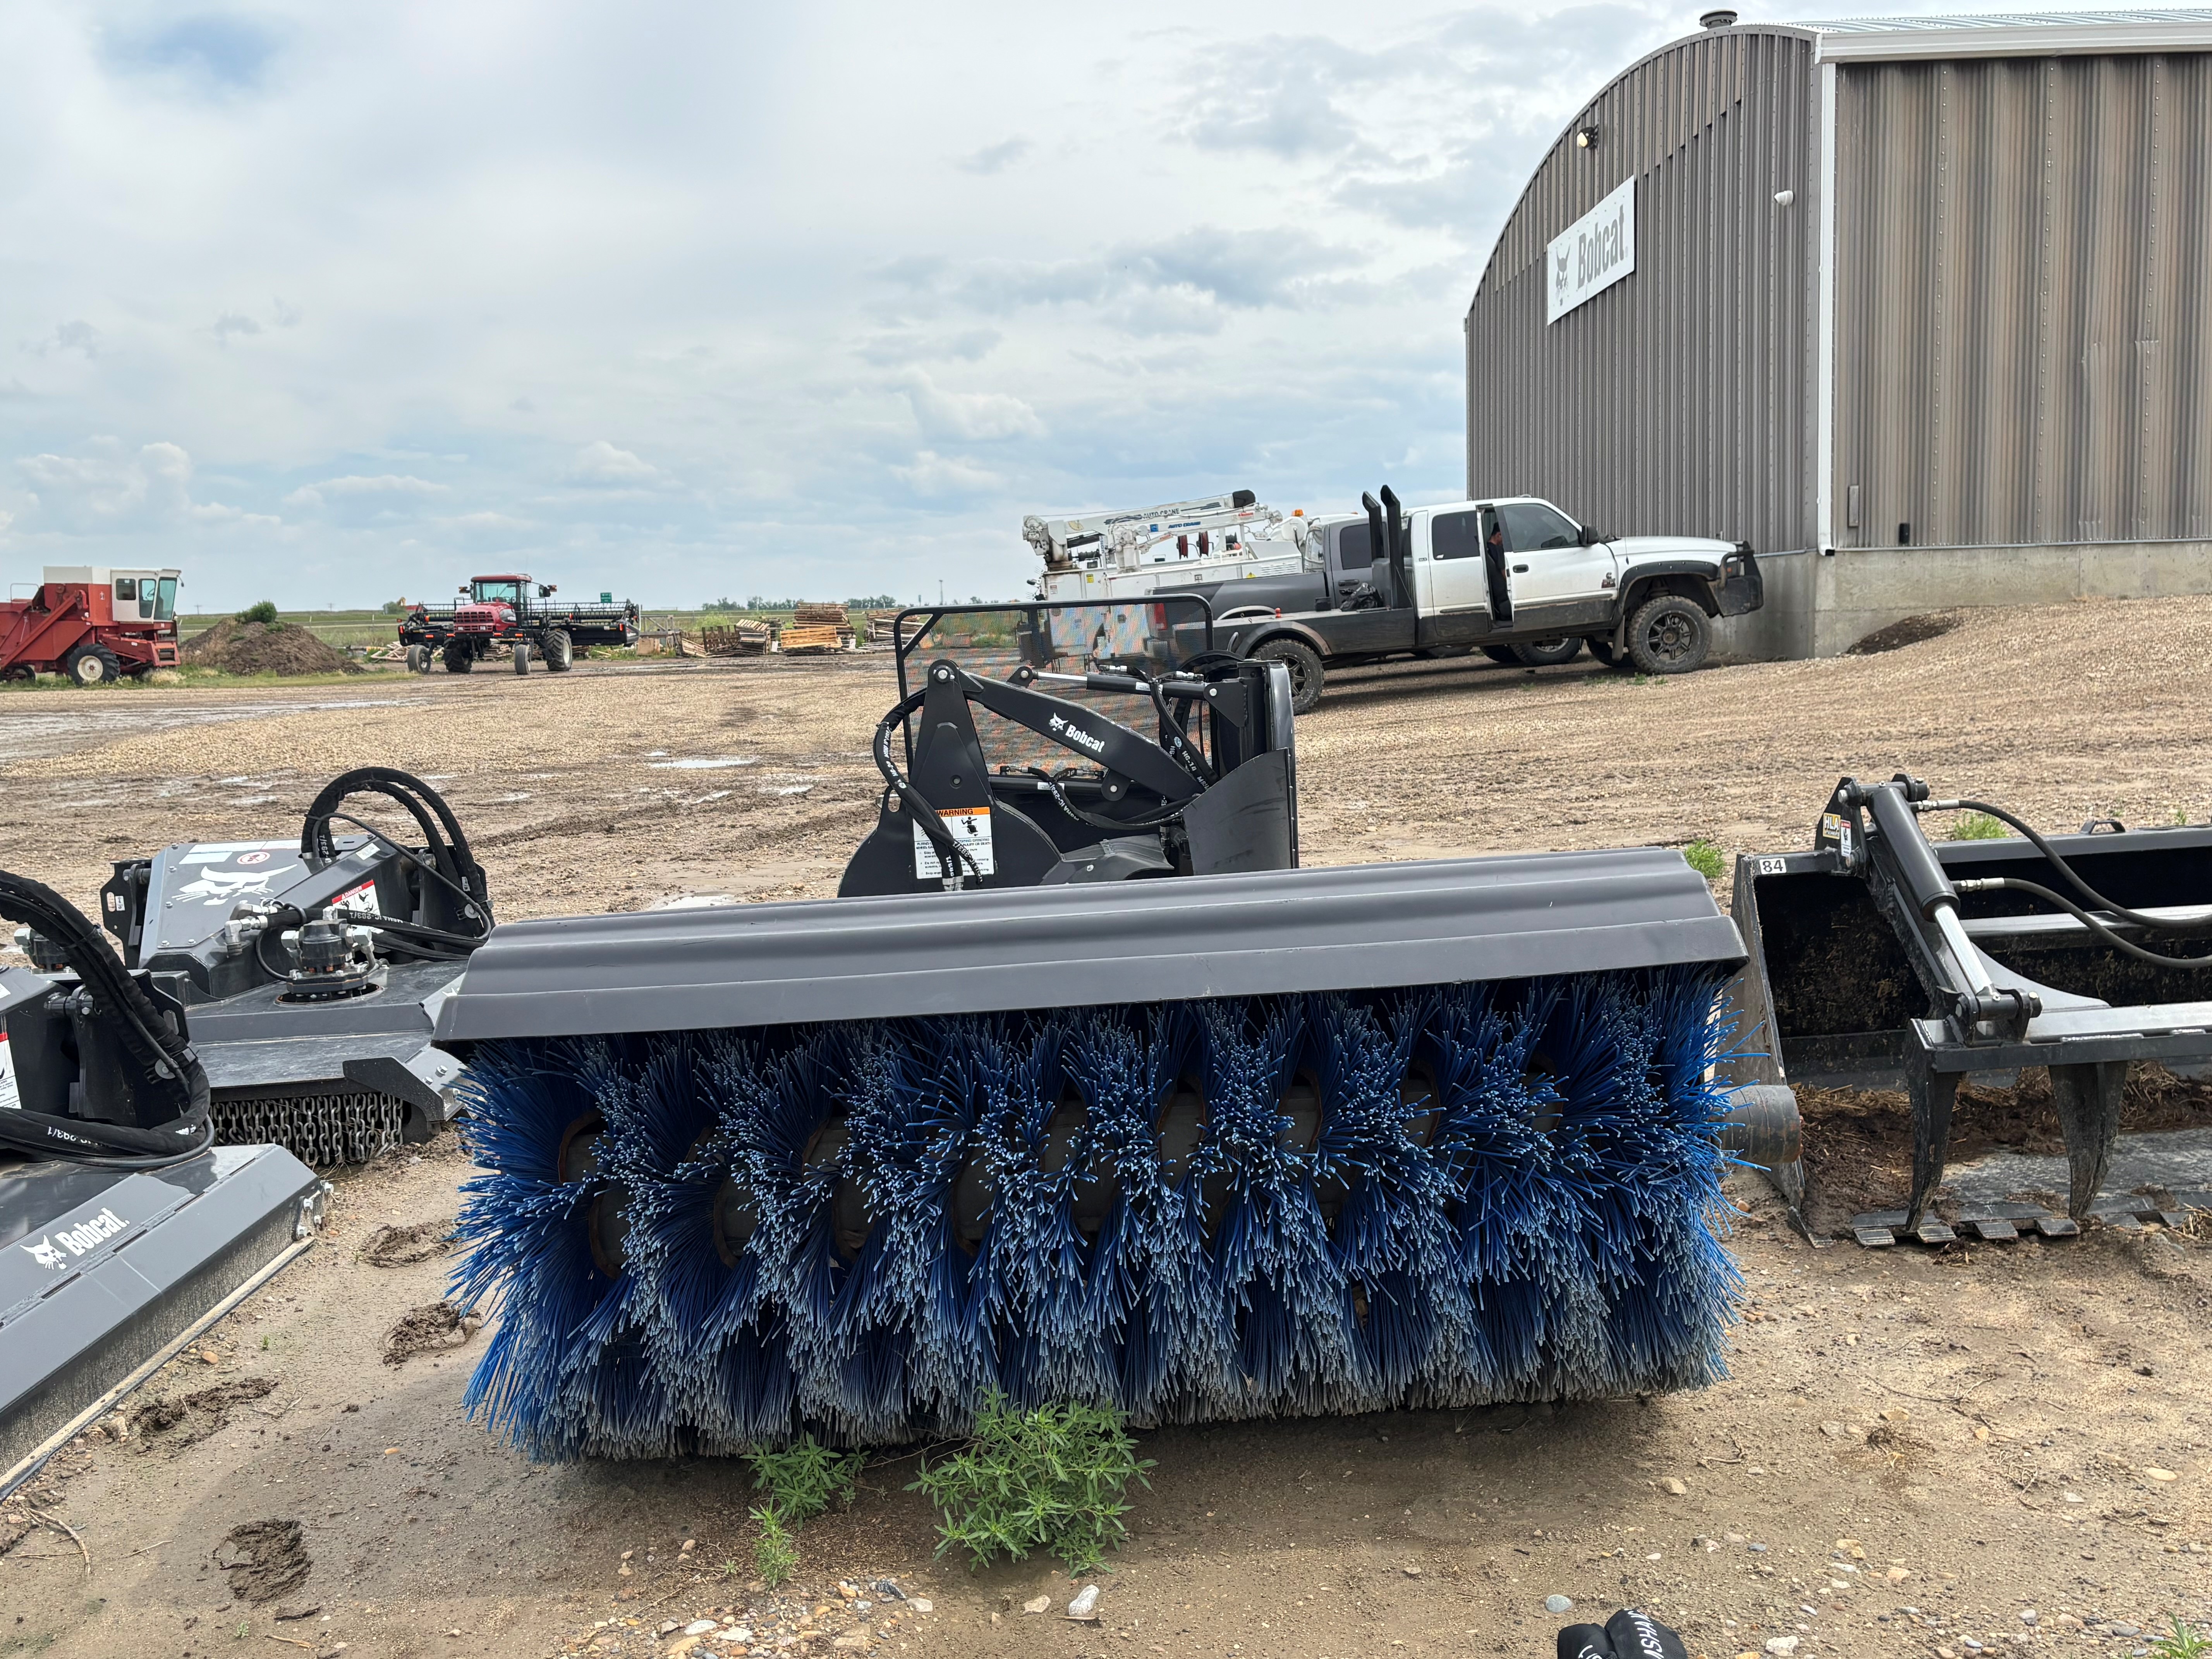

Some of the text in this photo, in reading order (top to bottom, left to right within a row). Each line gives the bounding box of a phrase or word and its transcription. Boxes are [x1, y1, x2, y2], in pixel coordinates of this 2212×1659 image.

[1578, 204, 1624, 289] Bobcat
[1160, 508, 1180, 516] CRANE
[1065, 724, 1105, 752] Bobcat
[1824, 815, 1839, 831] HLA
[1763, 860, 1783, 872] 84
[345, 886, 363, 898] DANGER
[55, 1207, 128, 1256] Bobcat
